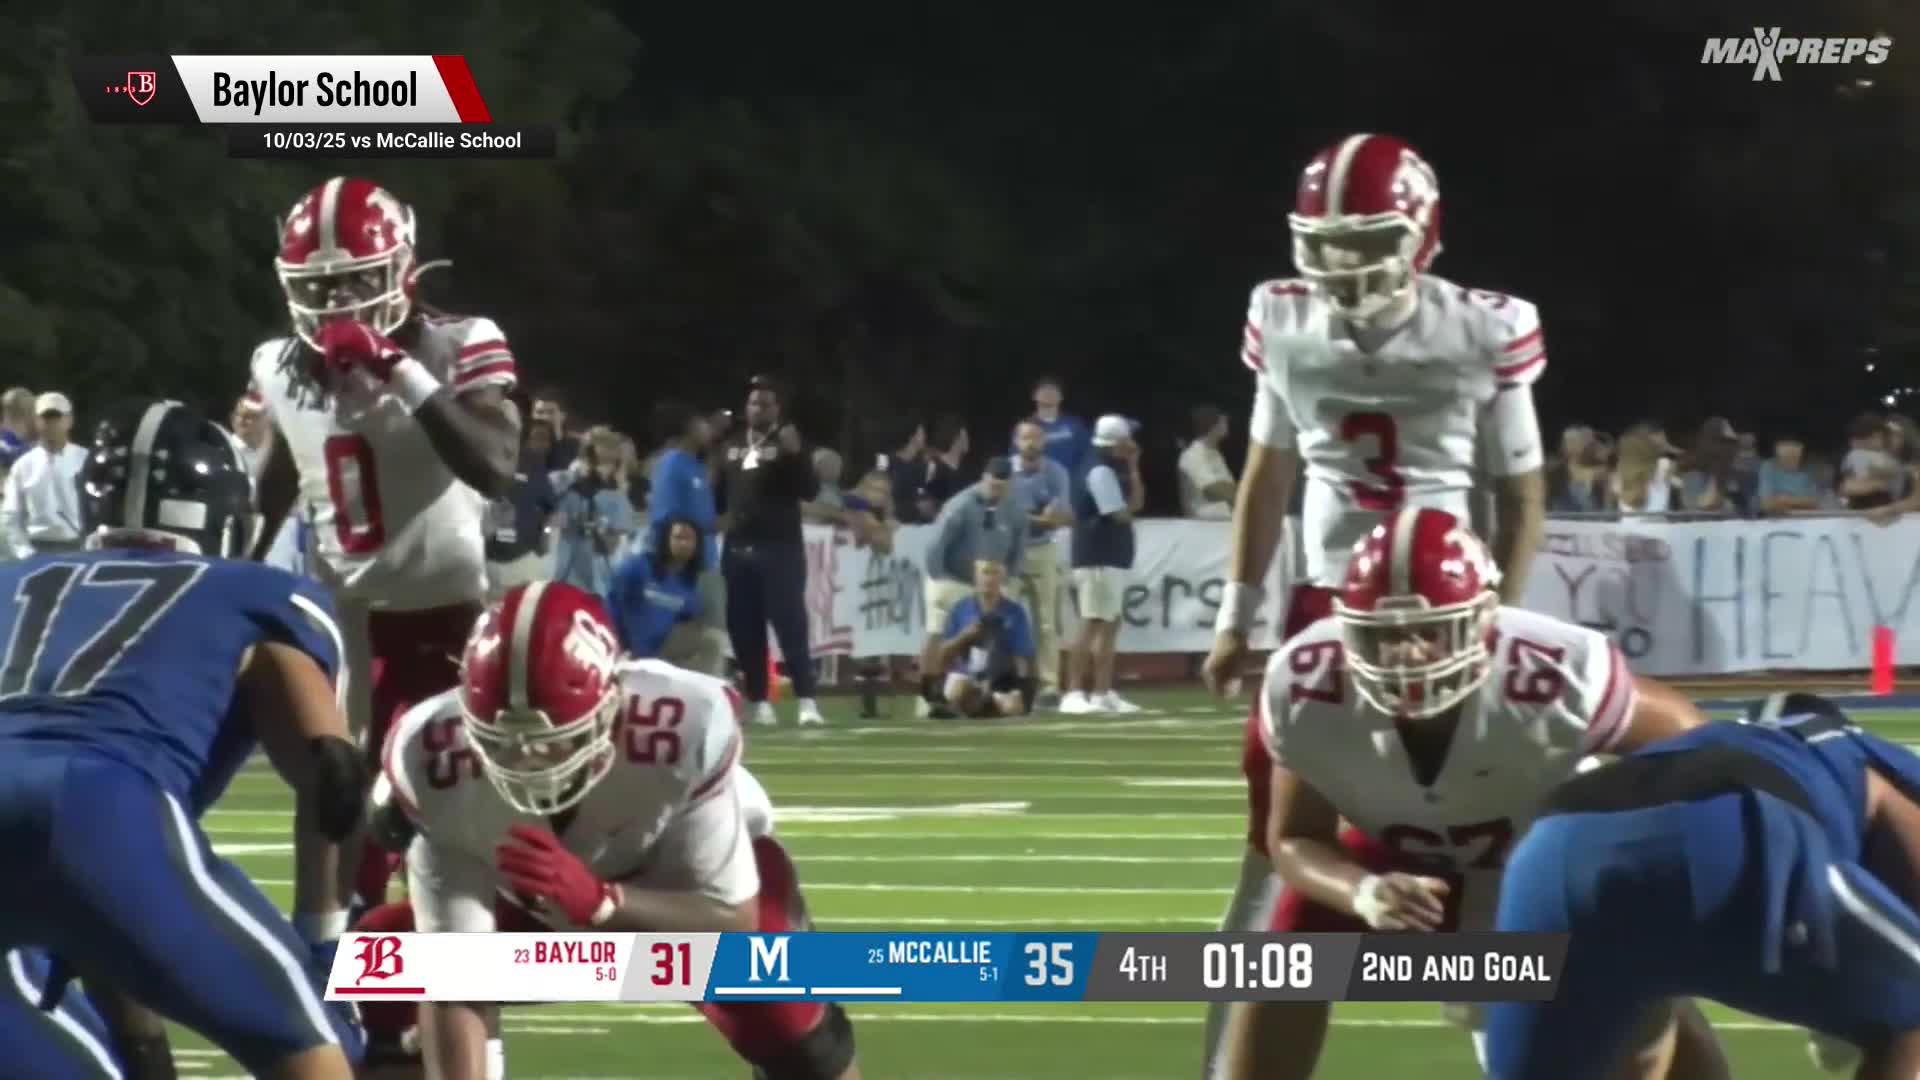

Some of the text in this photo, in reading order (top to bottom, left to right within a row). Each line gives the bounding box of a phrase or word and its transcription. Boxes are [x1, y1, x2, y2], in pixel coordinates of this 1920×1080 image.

[324, 433, 386, 554] 0
[1341, 411, 1407, 510] 3
[0, 560, 210, 698] 17
[1505, 638, 1567, 705] 67
[1289, 640, 1345, 704] 67
[627, 694, 686, 765] 55
